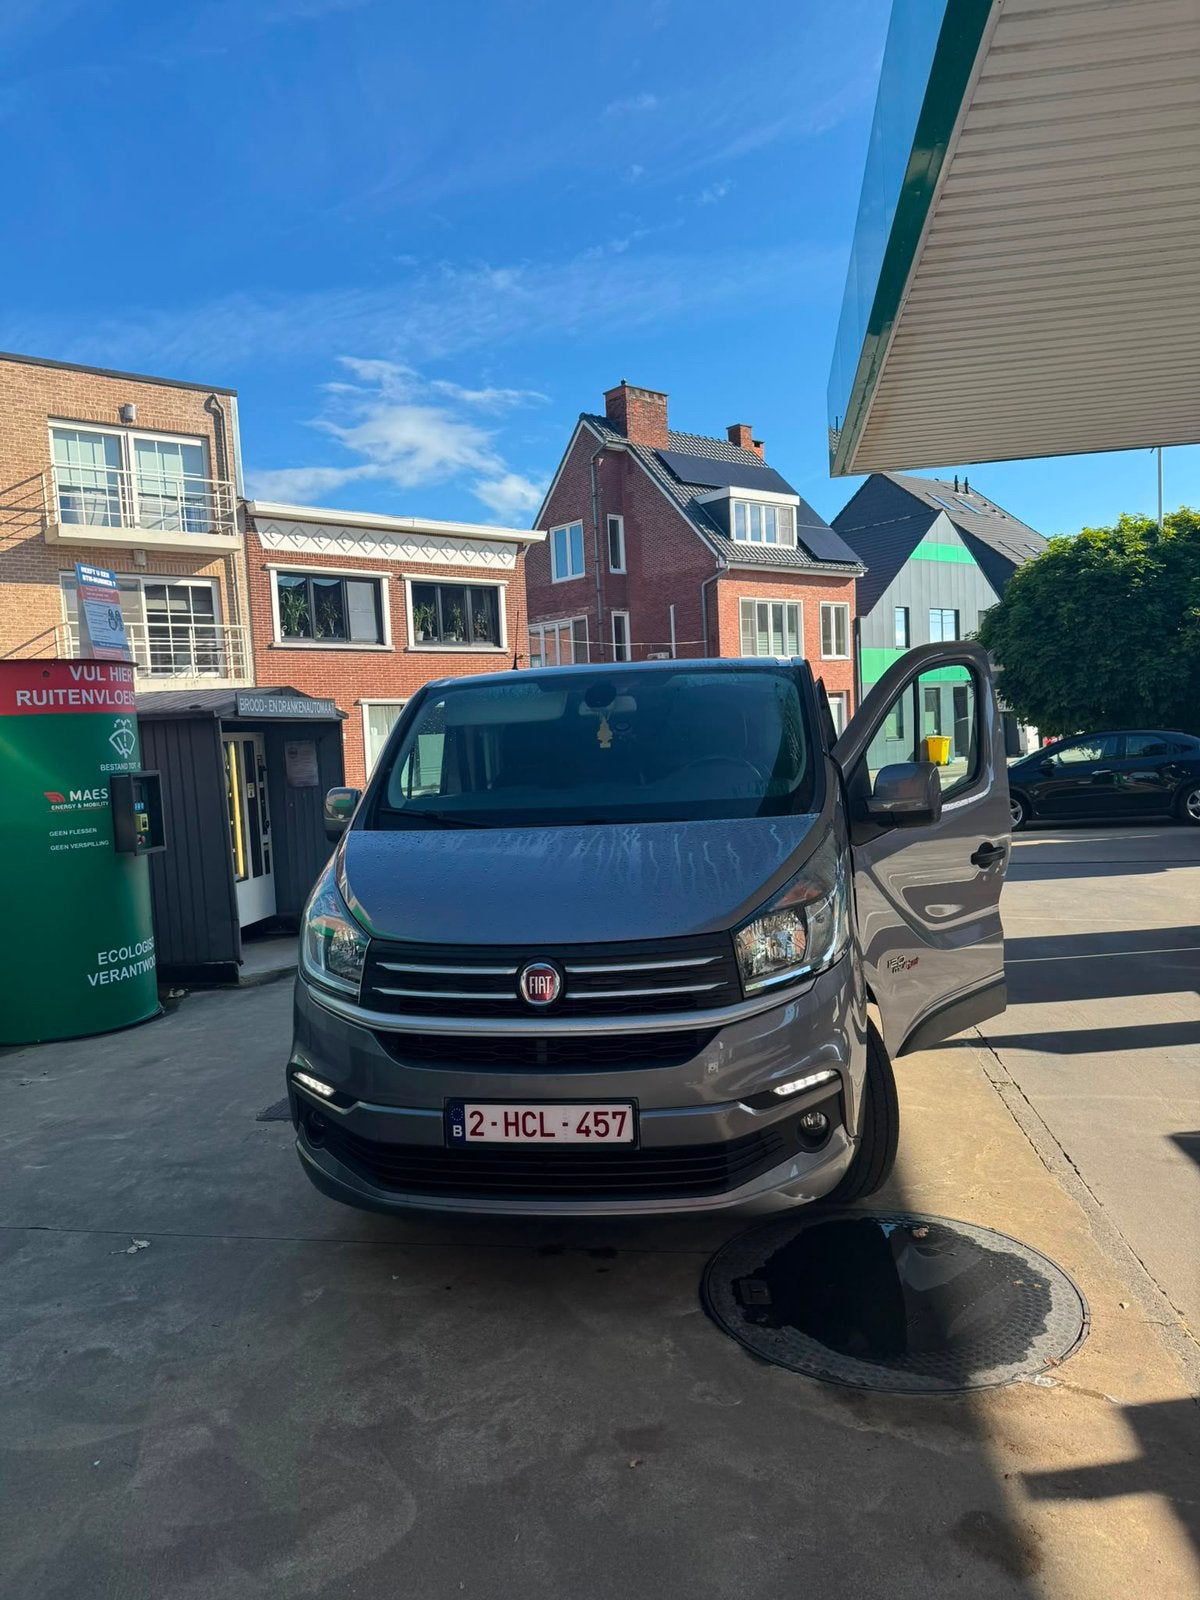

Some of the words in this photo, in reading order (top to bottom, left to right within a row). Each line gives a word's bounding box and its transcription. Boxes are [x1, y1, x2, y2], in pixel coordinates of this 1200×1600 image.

[69, 665, 106, 681] VUL
[109, 666, 132, 682] HIER
[268, 700, 278, 712] EN
[278, 700, 335, 714] DRANKENAUTOMAAT
[100, 762, 128, 771] BESTAND
[69, 788, 109, 802] MAES
[51, 803, 76, 811] ENERGY
[69, 827, 97, 835] FLESSEN
[70, 840, 109, 849] VERSPILLING
[529, 975, 552, 995] FIAT
[453, 1125, 463, 1137] B
